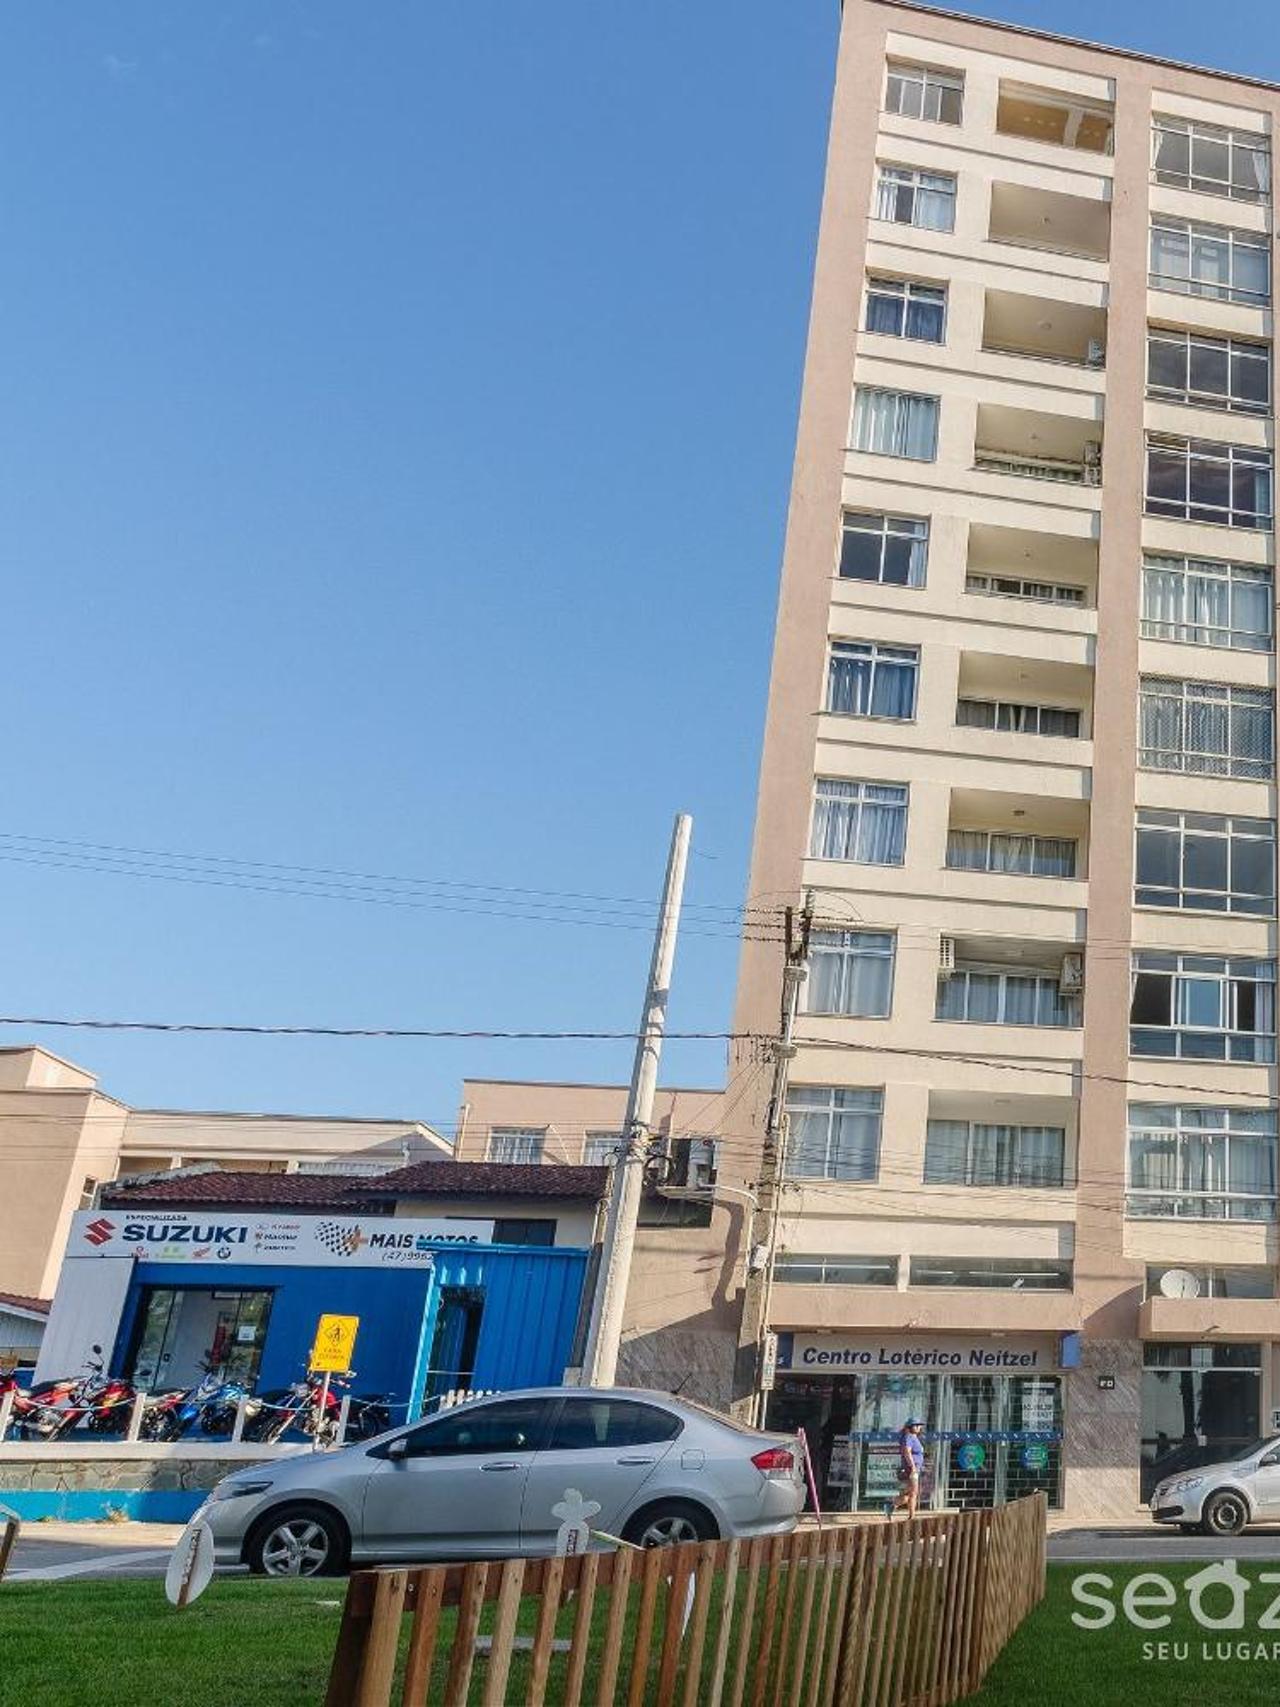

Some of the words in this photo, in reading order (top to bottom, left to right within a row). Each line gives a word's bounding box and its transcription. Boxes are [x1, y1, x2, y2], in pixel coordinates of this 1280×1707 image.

[122, 1223, 248, 1243] SUZUKI
[369, 1234, 413, 1248] MAIS
[803, 1348, 871, 1364] Centro
[878, 1347, 961, 1365] Lotérico
[969, 1349, 1038, 1367] Neitzel
